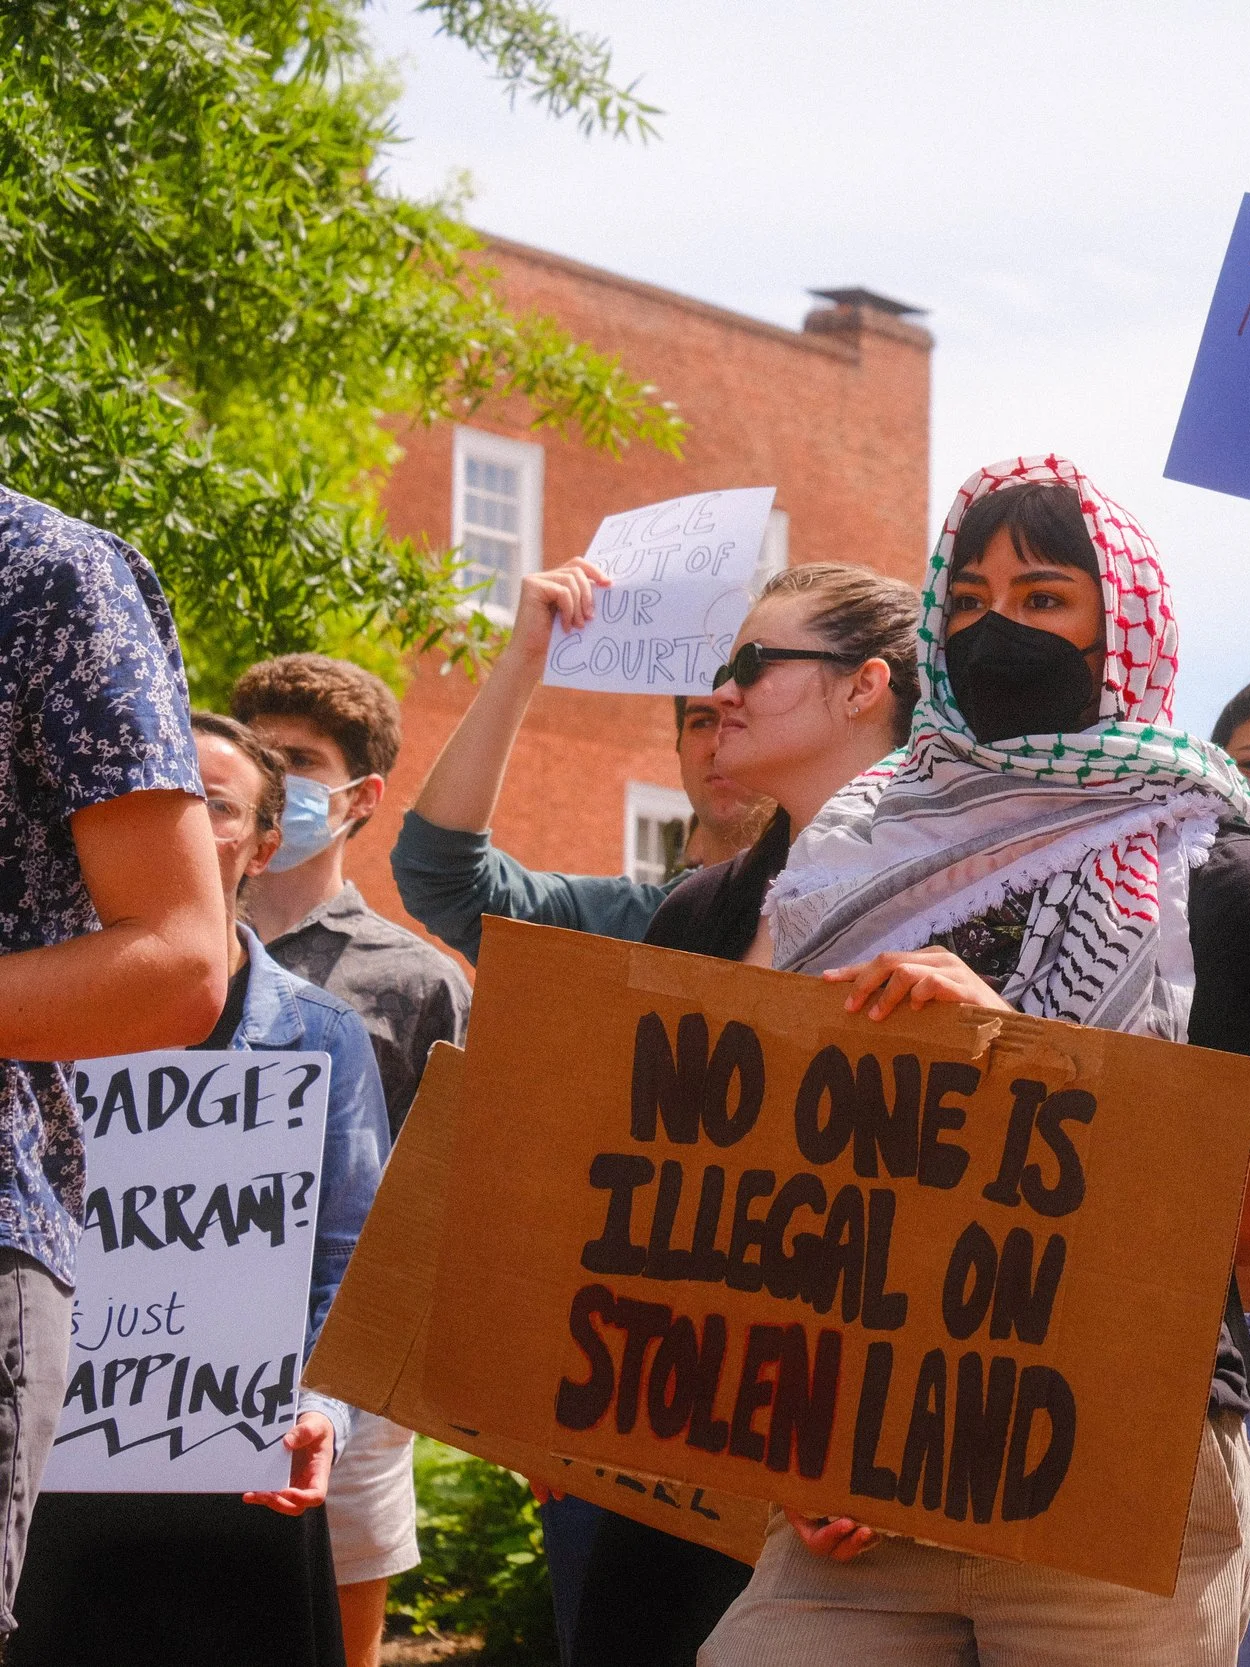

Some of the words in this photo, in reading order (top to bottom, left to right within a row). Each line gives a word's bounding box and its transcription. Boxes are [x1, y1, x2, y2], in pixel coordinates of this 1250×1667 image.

[598, 493, 722, 555] ICE
[602, 589, 661, 626] UR
[550, 633, 734, 687] COURTS
[75, 1062, 322, 1139] BADGE?
[629, 1011, 766, 1148] NO
[794, 1044, 982, 1190] ONE
[982, 1079, 1097, 1218] IS
[84, 1171, 316, 1253] ARRANT?
[580, 1153, 908, 1331] ILLEGAL
[941, 1220, 1067, 1345] ON
[76, 1291, 185, 1351] just
[62, 1353, 297, 1427] APPING!
[554, 1283, 844, 1480] STOLEN
[849, 1341, 1077, 1525] LAND
